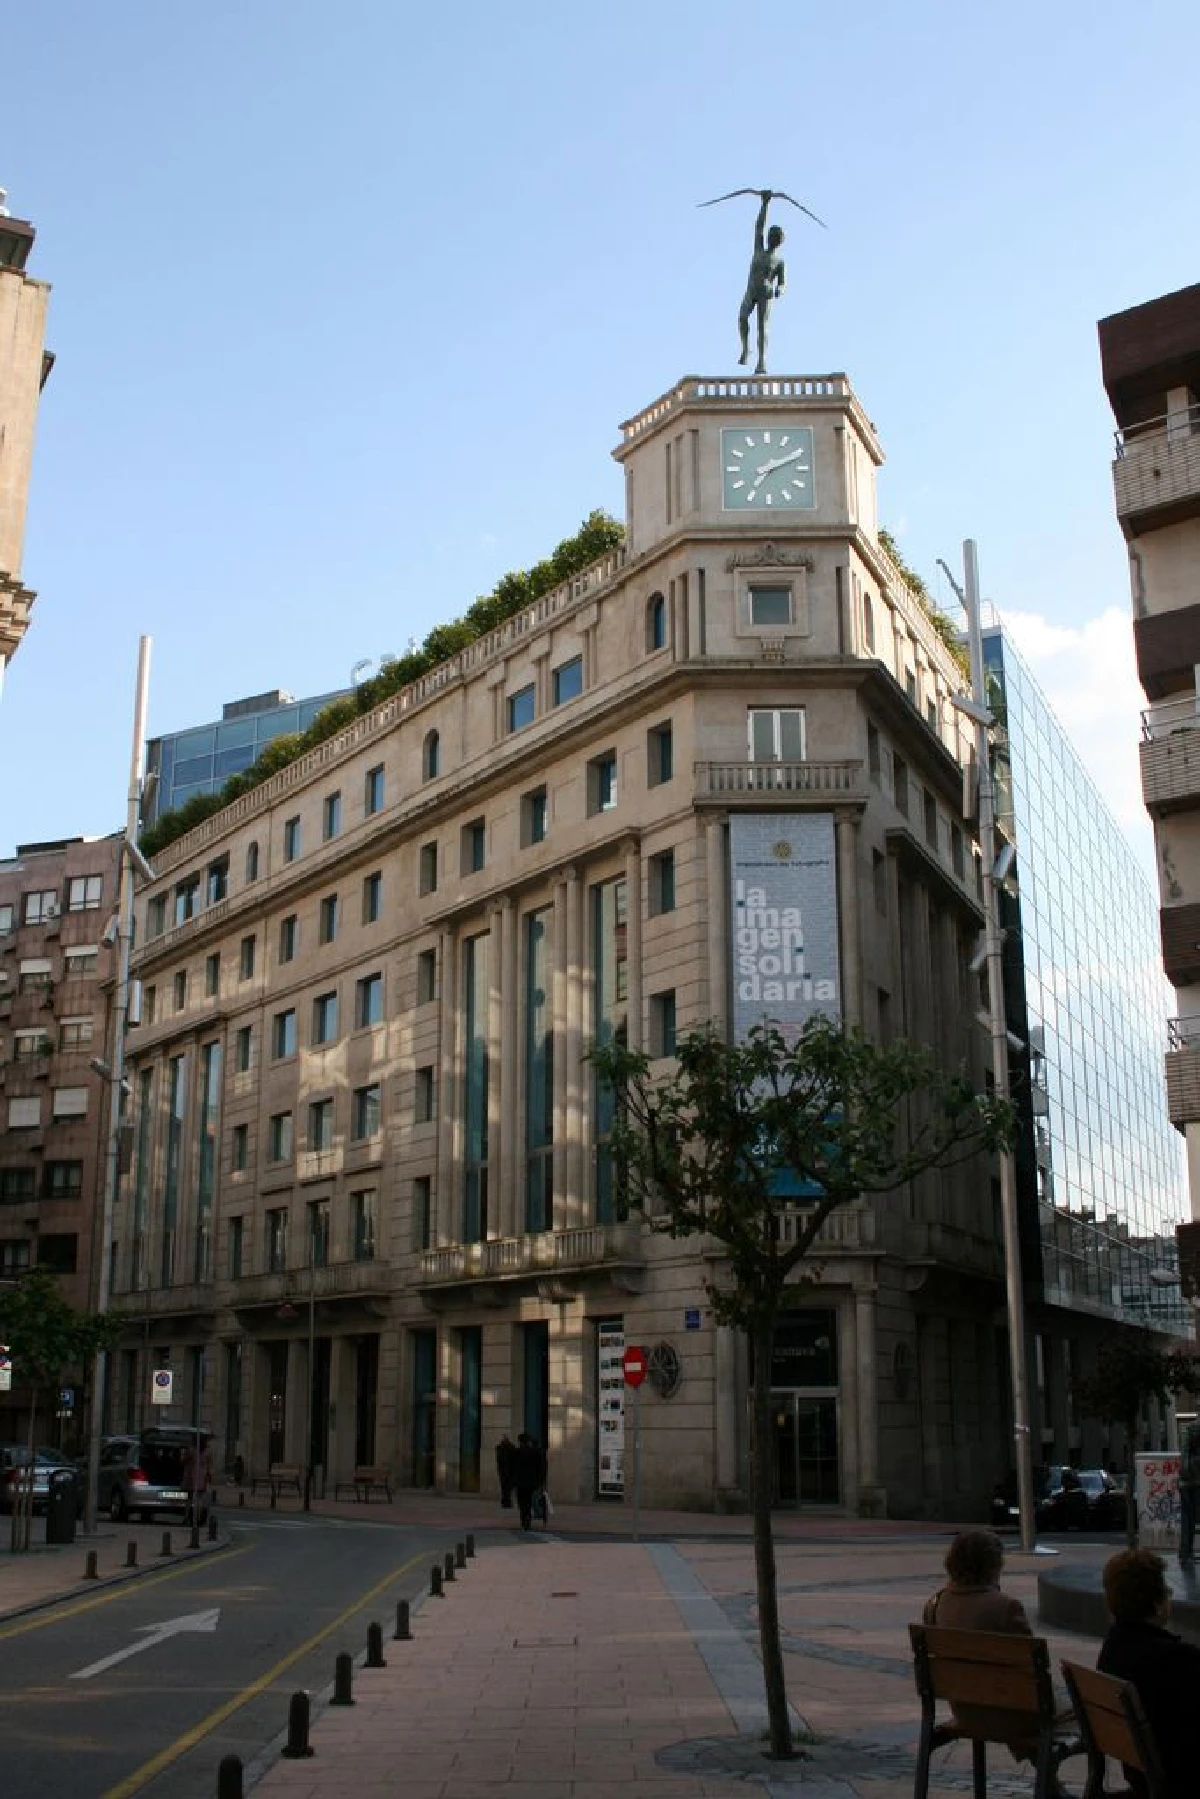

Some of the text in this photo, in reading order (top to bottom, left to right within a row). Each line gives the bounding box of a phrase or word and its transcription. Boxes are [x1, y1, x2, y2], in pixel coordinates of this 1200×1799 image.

[737, 880, 766, 907] la
[737, 901, 801, 928] ima
[738, 928, 803, 955] gen
[739, 947, 804, 976] soli
[740, 973, 836, 1000] daria
